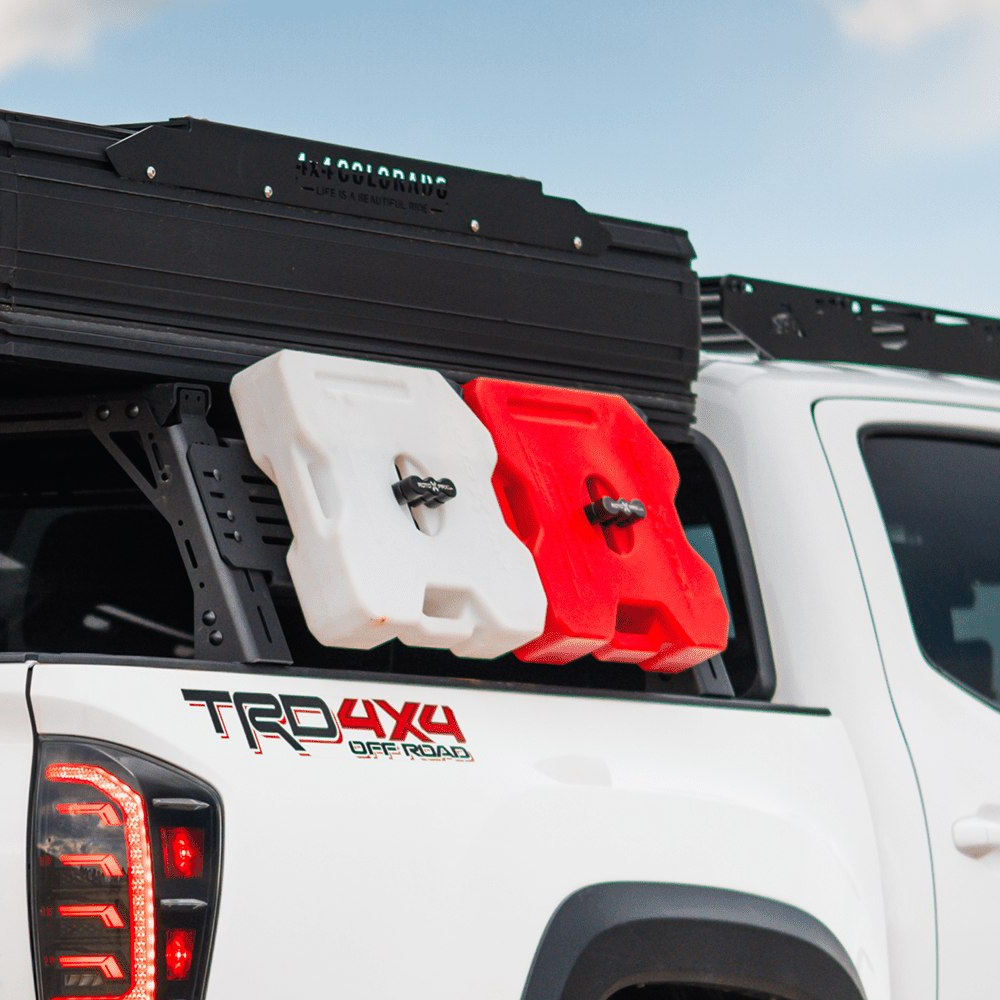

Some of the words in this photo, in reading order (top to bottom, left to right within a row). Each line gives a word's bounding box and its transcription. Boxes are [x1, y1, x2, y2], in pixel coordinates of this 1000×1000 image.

[316, 186, 336, 198] LIFE
[339, 190, 347, 200] IS
[350, 192, 356, 200] A
[358, 193, 406, 209] BEAUTIFUL
[408, 202, 428, 213] RIDE
[181, 688, 343, 757] TRD
[348, 740, 400, 760] OFF
[401, 742, 475, 762] ROAD
